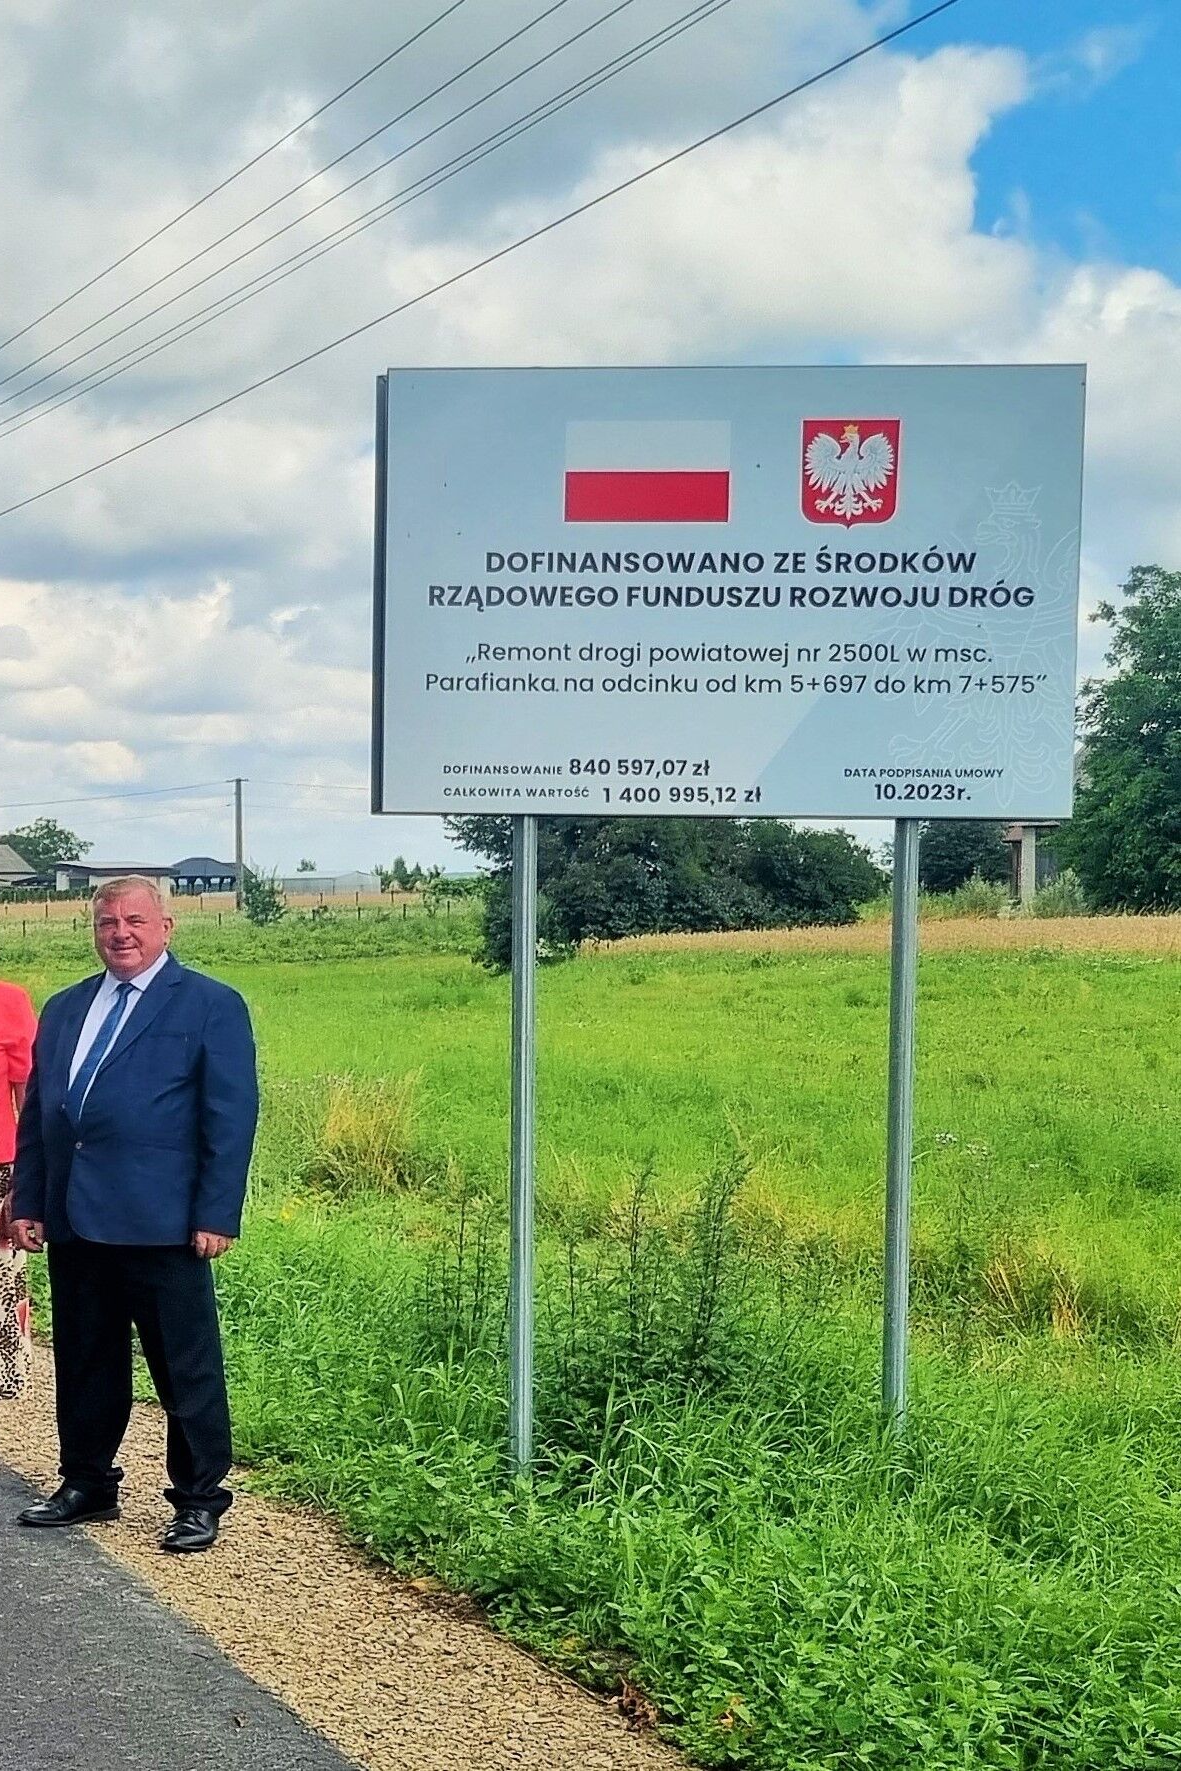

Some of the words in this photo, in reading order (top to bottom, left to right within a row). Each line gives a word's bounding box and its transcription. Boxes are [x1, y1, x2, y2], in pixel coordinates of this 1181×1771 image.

[485, 551, 765, 574] DOFINANSOWANO
[773, 551, 807, 574] ZE
[815, 544, 977, 574] ŚRODKÓW
[428, 584, 619, 613] RZĄDOWEGO
[626, 585, 782, 608] FUNDUSZU
[789, 585, 940, 608] ROZWOJU
[947, 579, 1035, 608] DRÓG
[578, 642, 642, 668] drogi
[648, 641, 790, 669] powiatowej
[797, 647, 821, 663] nr
[829, 643, 901, 663] 2500L
[907, 647, 928, 663] w
[934, 647, 993, 663] msc.
[563, 677, 594, 693] na
[601, 672, 698, 693] odcinku
[705, 673, 737, 694] od
[744, 673, 782, 694] km
[790, 674, 868, 694] 5+697
[874, 674, 906, 694] do
[913, 674, 952, 694] km
[442, 764, 563, 776] DOFINANSOWANIE
[568, 758, 611, 776] 840
[617, 758, 688, 780] 597,07
[691, 759, 711, 777] zł
[843, 768, 877, 778] DATA
[879, 768, 952, 778] PODPISANIA
[954, 768, 1004, 779] UMOWY
[443, 786, 521, 798] CAŁKOWITA
[525, 785, 590, 798] WARTOŚĆ
[602, 787, 611, 803] 1
[618, 787, 661, 804] 400
[668, 786, 737, 806] 995,12
[743, 786, 762, 803] zł
[874, 783, 972, 801] 10.2023r.
